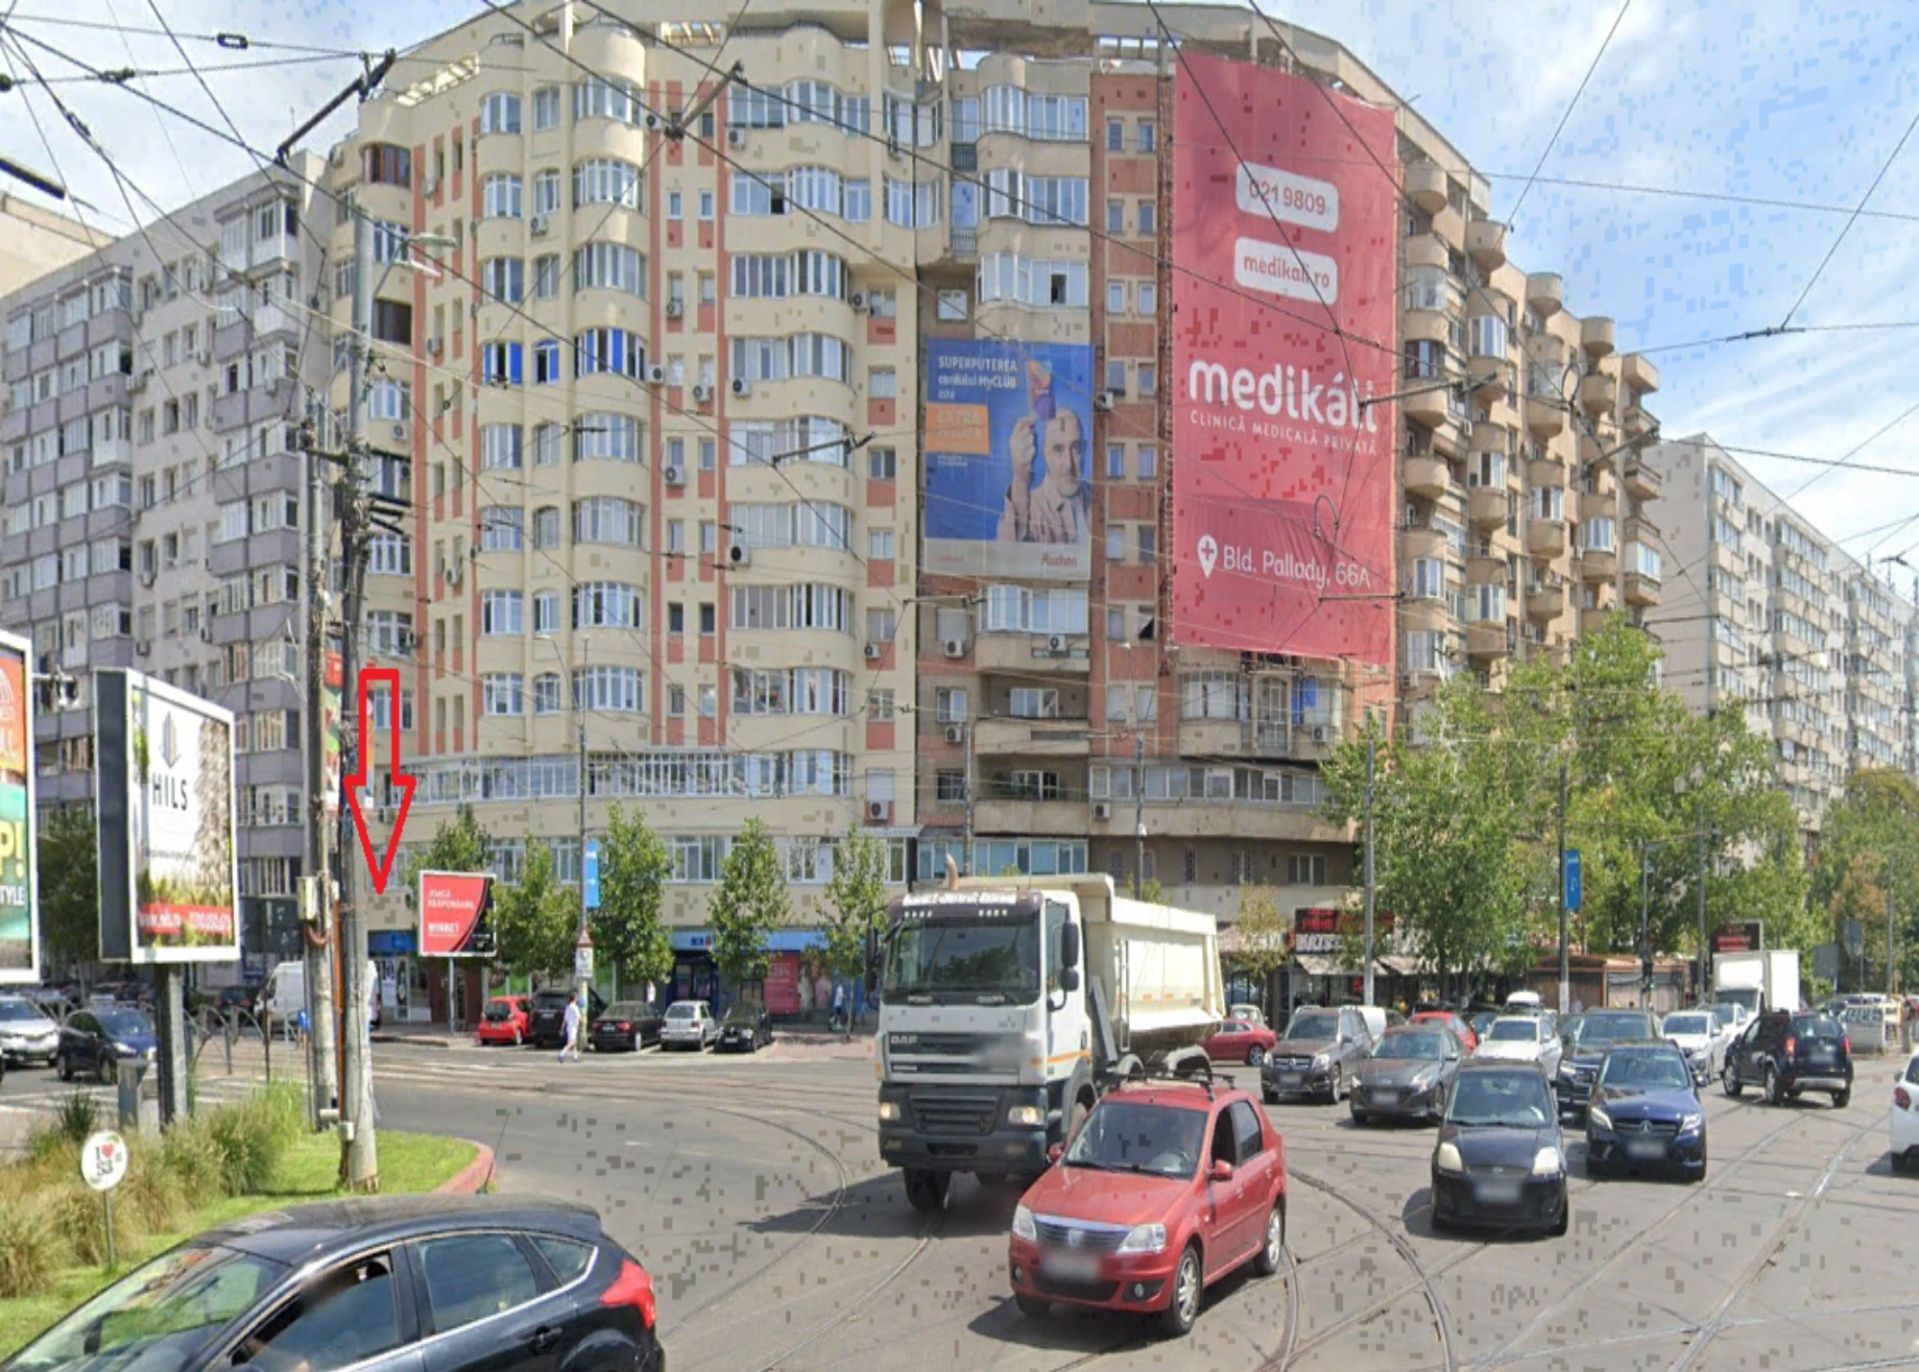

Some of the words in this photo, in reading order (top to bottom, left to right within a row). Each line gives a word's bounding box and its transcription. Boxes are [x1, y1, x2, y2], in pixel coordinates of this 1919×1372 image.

[1248, 179, 1279, 204] 021
[1283, 186, 1326, 216] 9809
[1243, 255, 1330, 289] medikaliro
[938, 355, 1018, 373] SUPERPUTEREA
[979, 374, 1018, 391] MyCLUB
[1189, 360, 1378, 432] medikáli
[1190, 408, 1246, 433] CLINICĂ
[1223, 544, 1257, 573] Bld.
[1263, 550, 1331, 590] Pallady,
[1335, 561, 1371, 589] 66A
[152, 772, 188, 812] HILS
[891, 1036, 918, 1044] DAF
